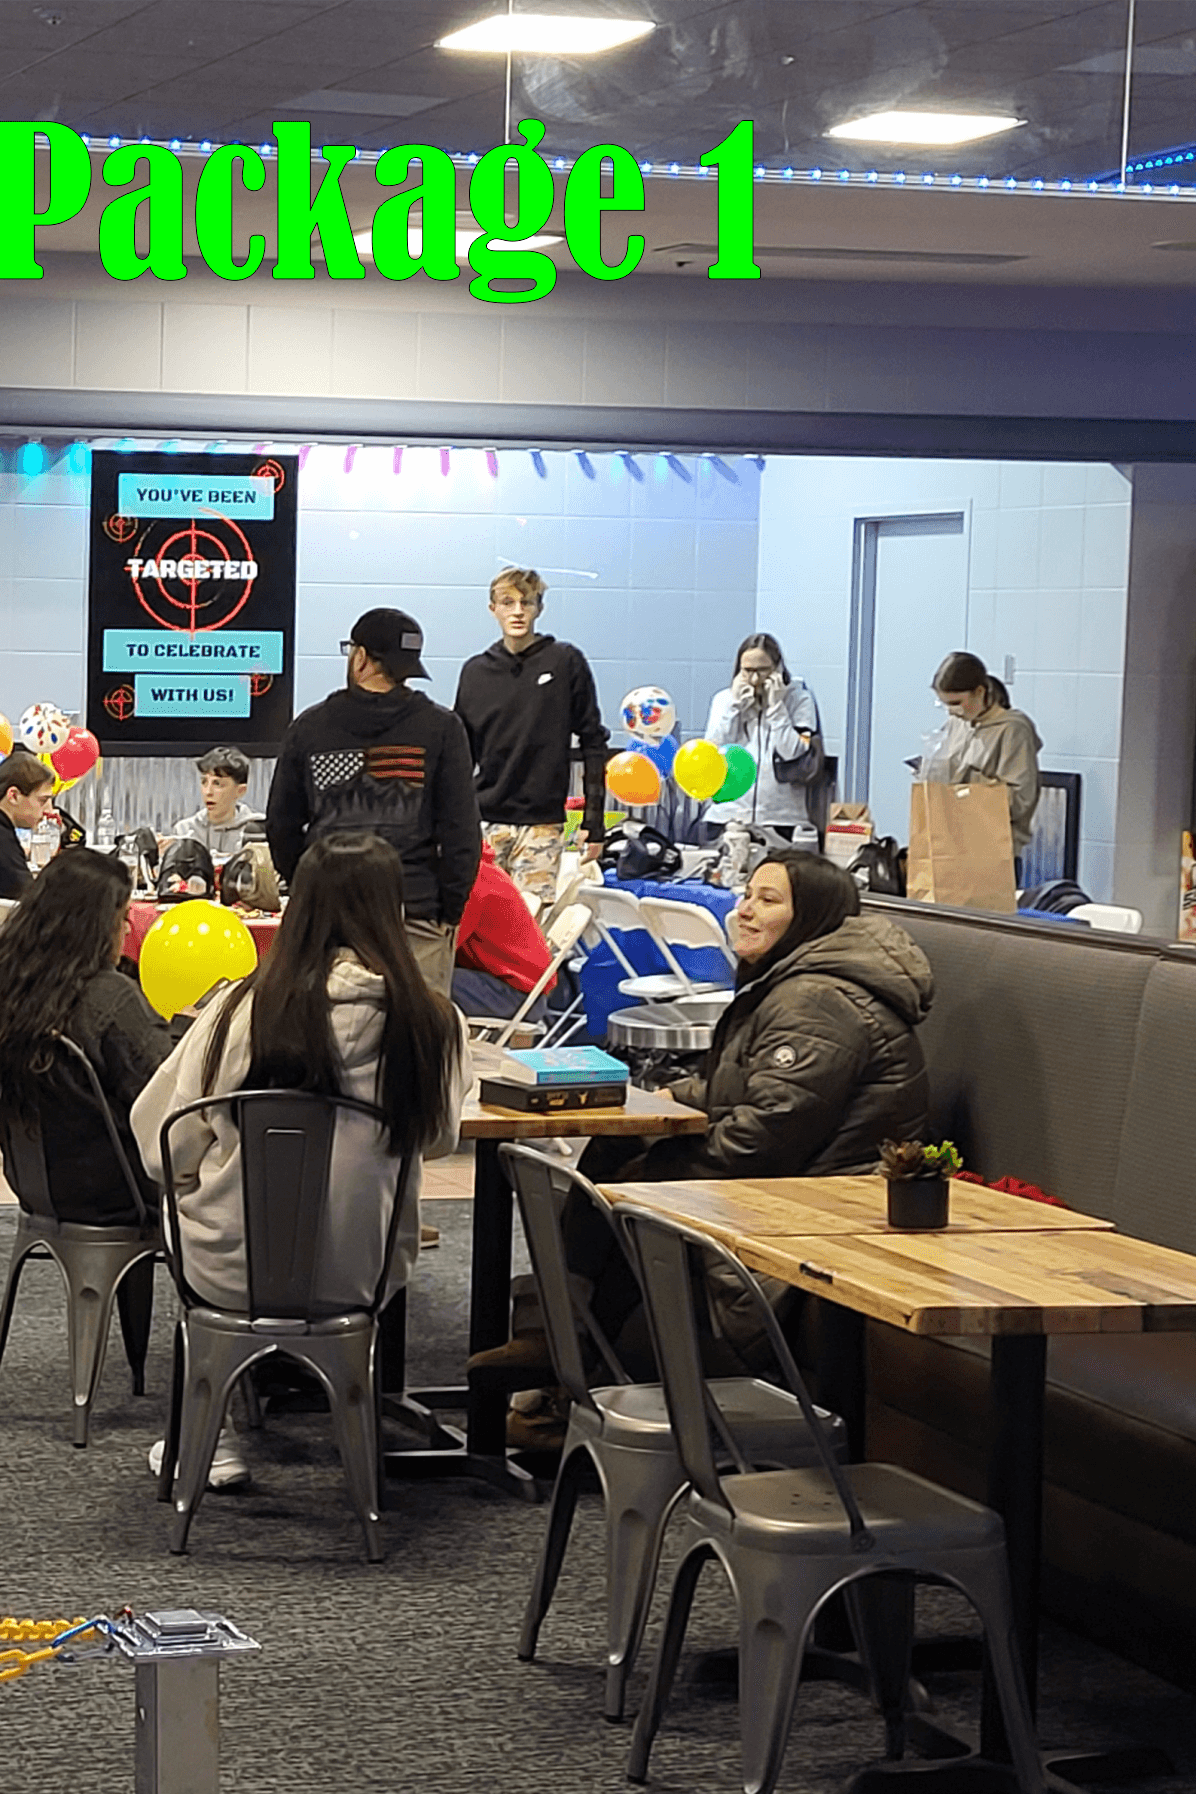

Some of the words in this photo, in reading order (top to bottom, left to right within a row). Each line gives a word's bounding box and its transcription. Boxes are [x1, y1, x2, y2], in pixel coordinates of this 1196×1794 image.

[136, 488, 203, 502] YOU'VE
[208, 490, 257, 504] BEEN
[126, 558, 259, 580] TARGETED
[125, 643, 150, 658] TO
[154, 643, 261, 658] CELEBRATE
[150, 688, 201, 702] WITH
[203, 688, 234, 702] US!
